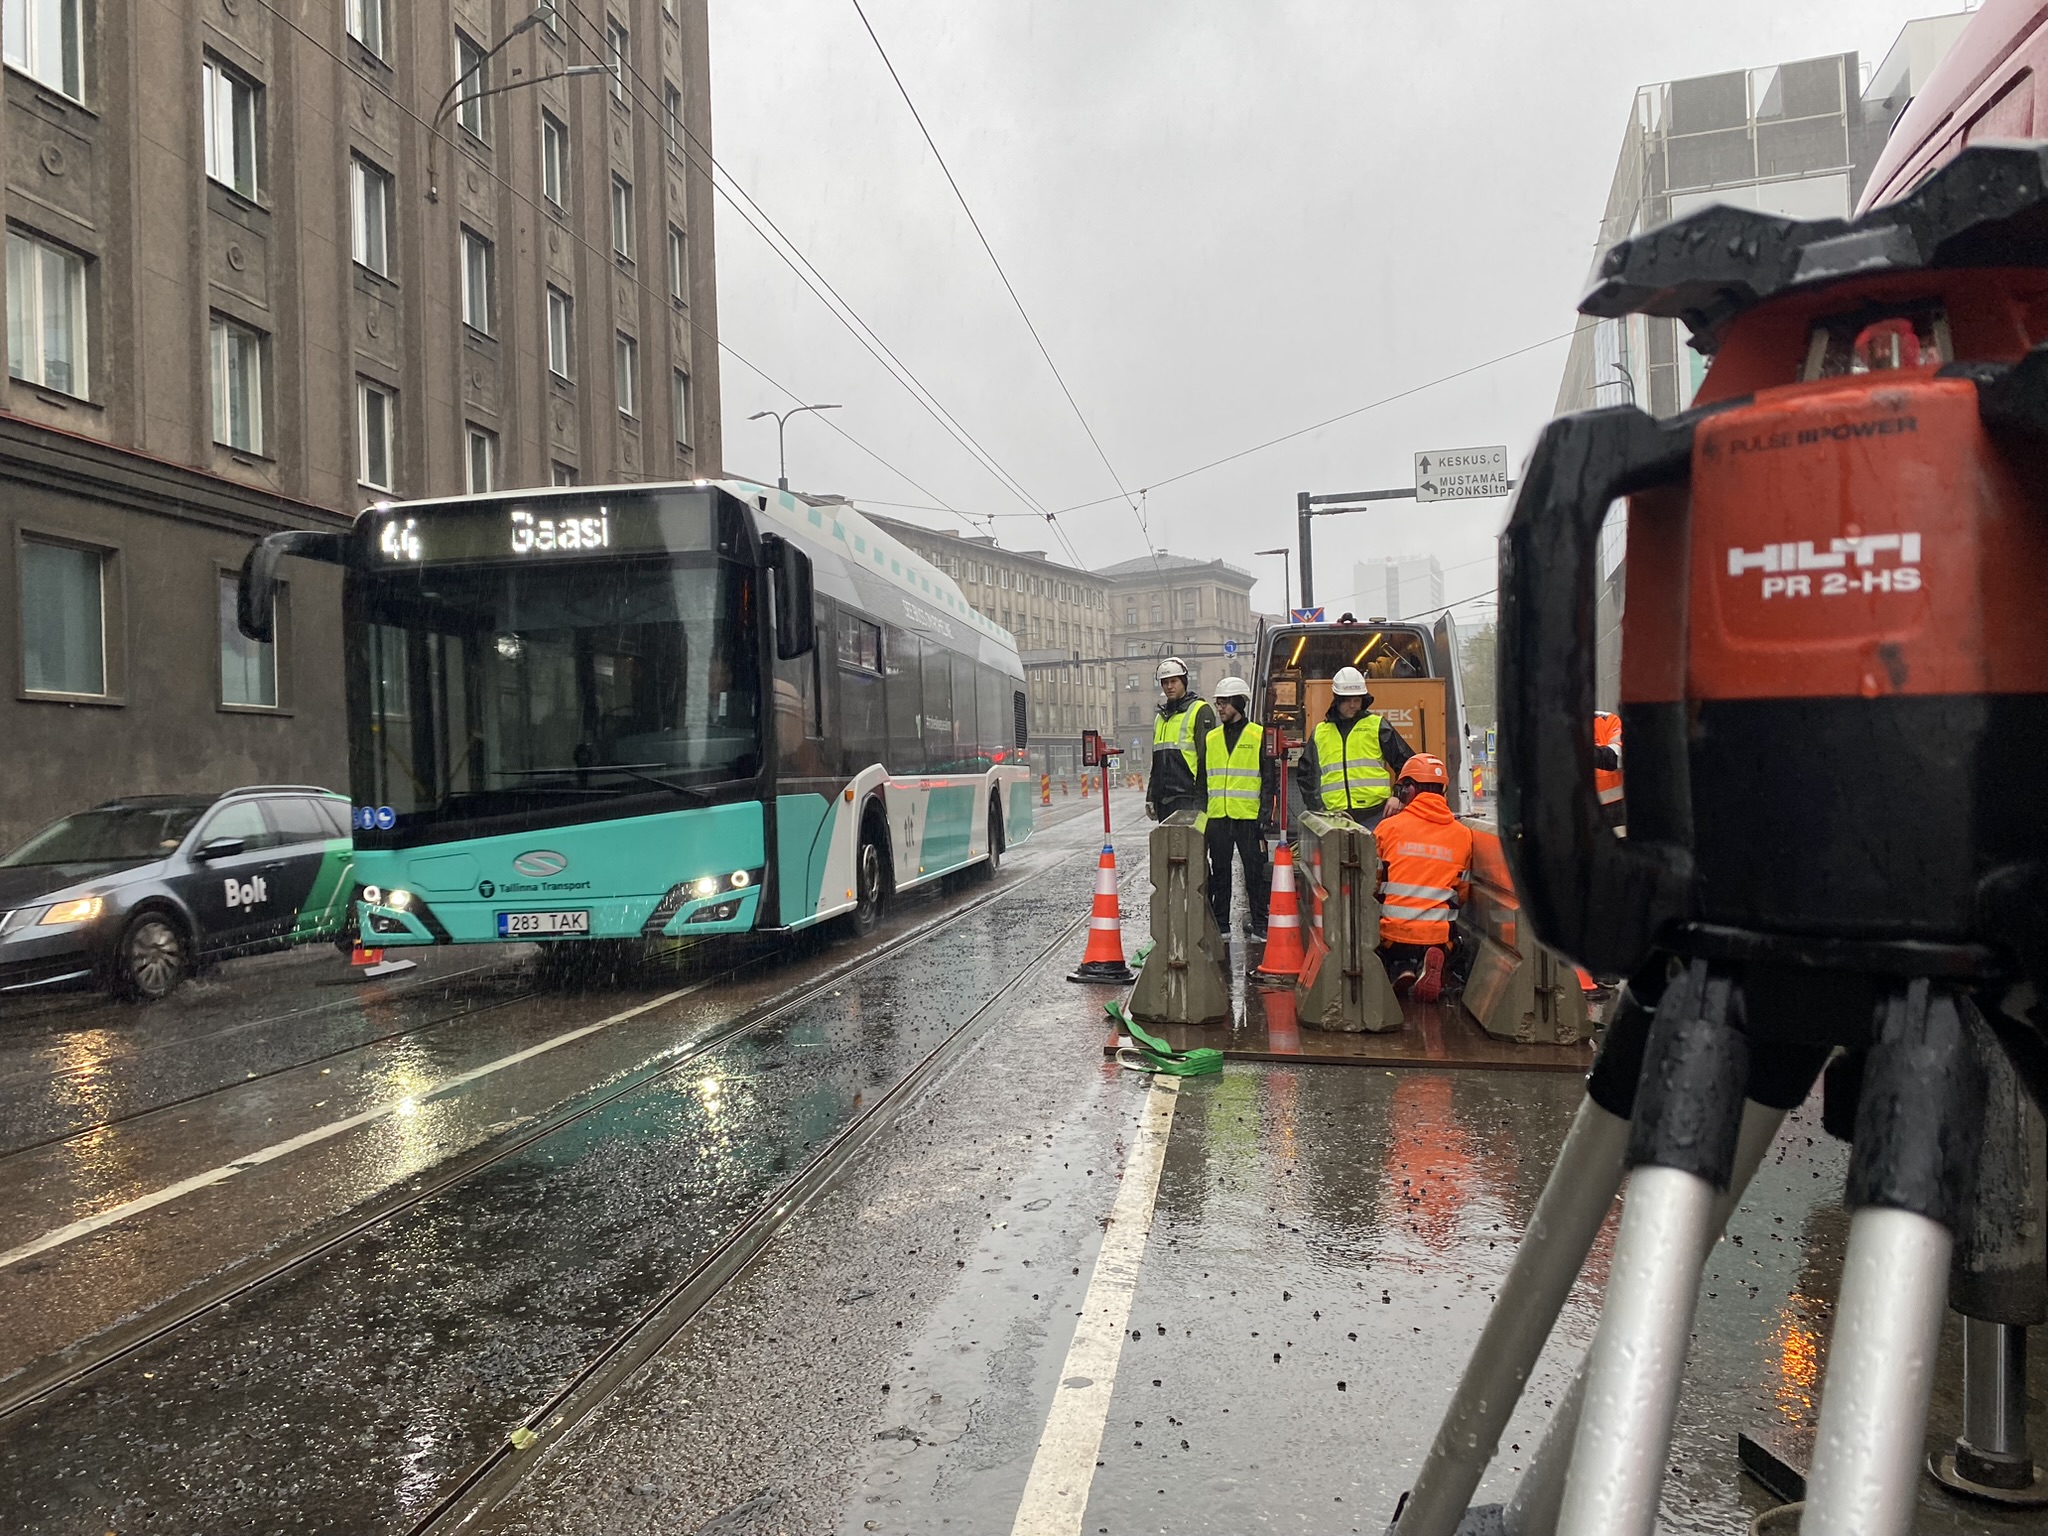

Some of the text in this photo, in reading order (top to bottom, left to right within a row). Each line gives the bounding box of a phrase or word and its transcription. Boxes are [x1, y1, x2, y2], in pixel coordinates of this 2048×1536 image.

[1439, 454, 1500, 467] KESKUS, C
[1440, 471, 1505, 486] MUSTAMÄE
[1440, 485, 1506, 497] PRONKSI tn
[511, 506, 608, 551] Gaasi
[1728, 533, 1922, 577] HILTI
[1762, 568, 1922, 600] PR 2-HS
[224, 875, 267, 913] Bolt
[499, 881, 591, 893] Tallinna Transport
[512, 914, 582, 931] 283 TAK
